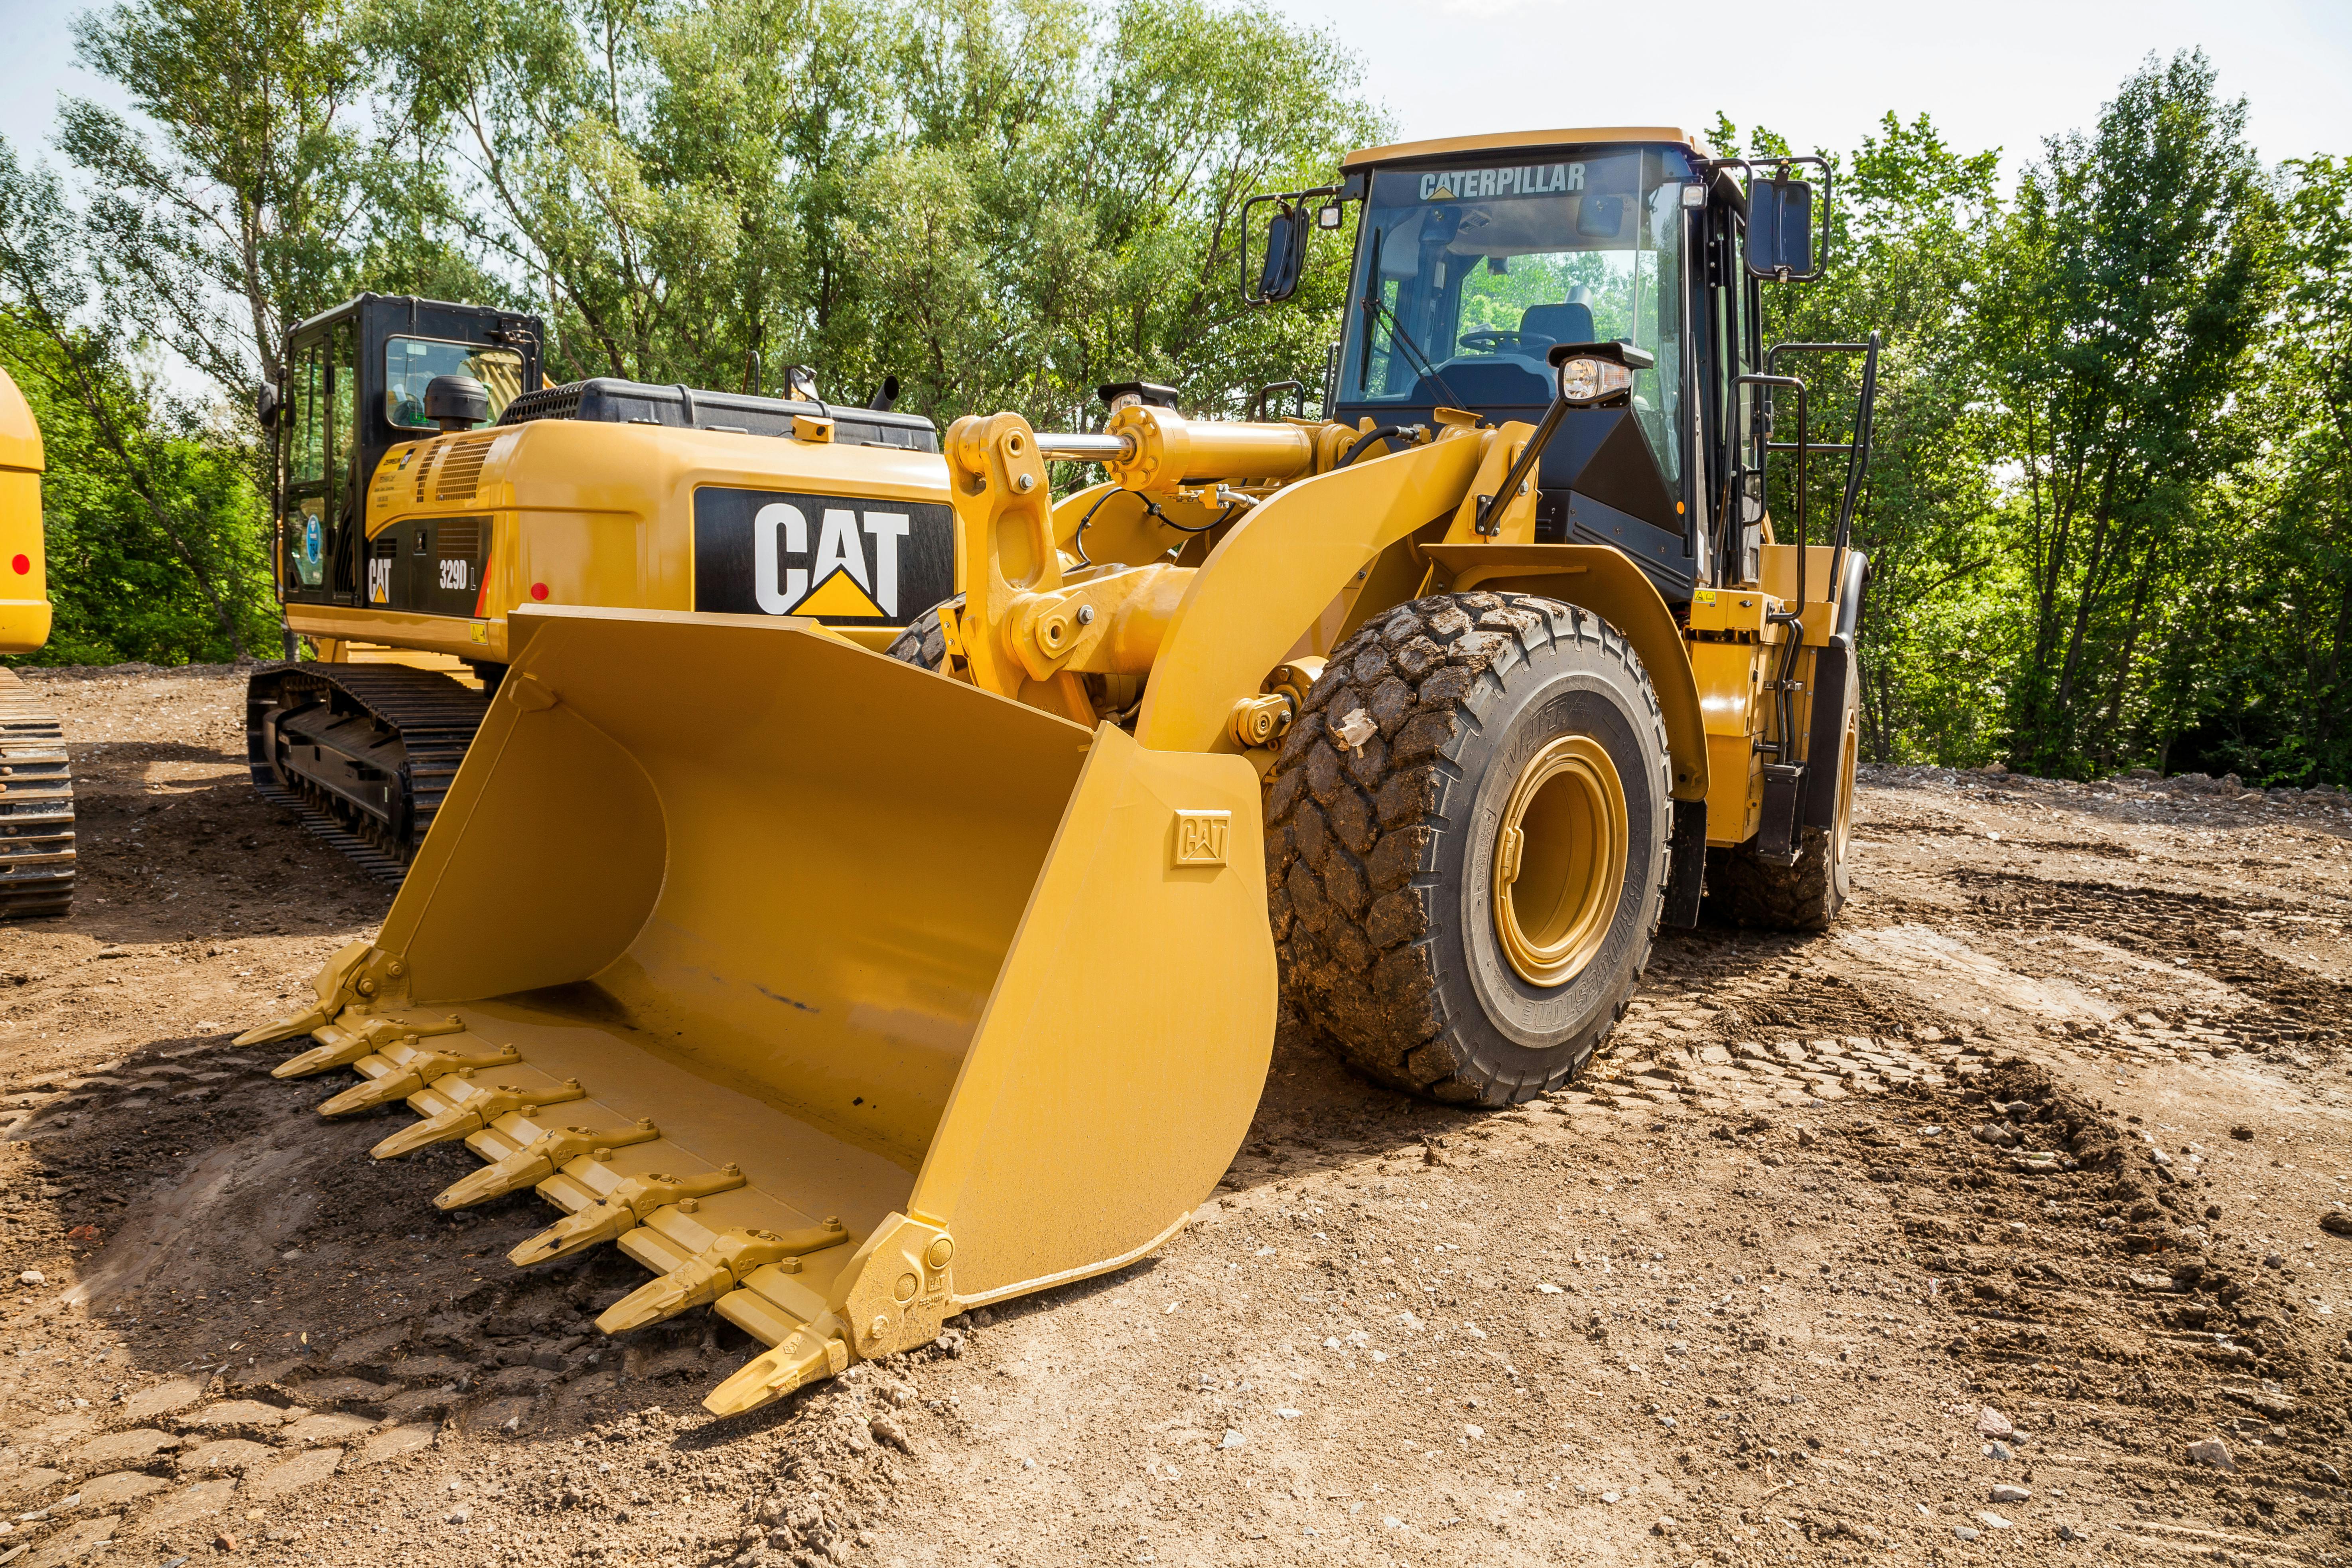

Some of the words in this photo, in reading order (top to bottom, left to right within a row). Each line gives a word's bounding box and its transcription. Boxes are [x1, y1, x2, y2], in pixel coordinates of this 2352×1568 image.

[1419, 163, 1585, 200] CATERPILLAR
[440, 560, 467, 590] 329D
[471, 567, 476, 590] L
[754, 503, 909, 617] CAT
[369, 558, 391, 603] CAT
[1179, 819, 1227, 859] CAT
[928, 1274, 945, 1292] CAT
